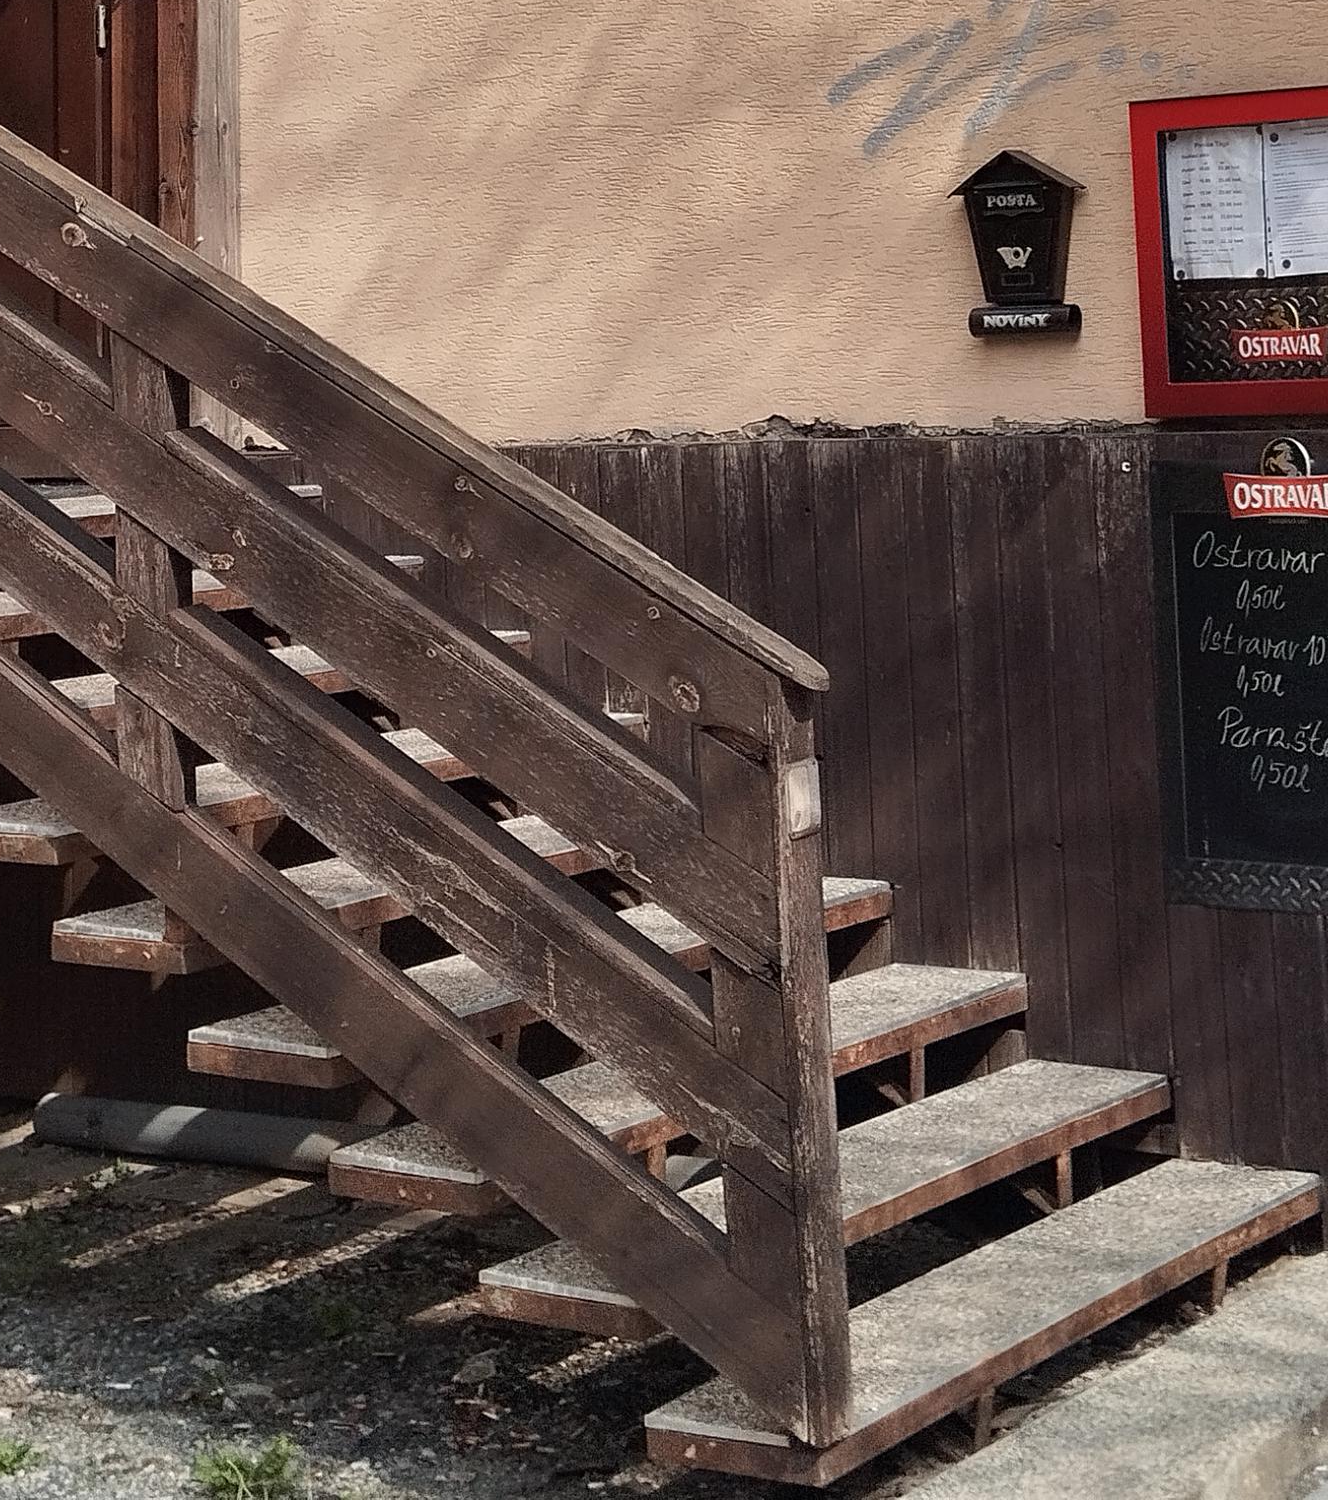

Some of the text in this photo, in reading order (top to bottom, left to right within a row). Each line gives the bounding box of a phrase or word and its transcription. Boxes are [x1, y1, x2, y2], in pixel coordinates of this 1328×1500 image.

[1238, 334, 1323, 359] OSTRAVAR
[1193, 530, 1325, 574] Ostravar
[1199, 616, 1300, 661] Ostravar
